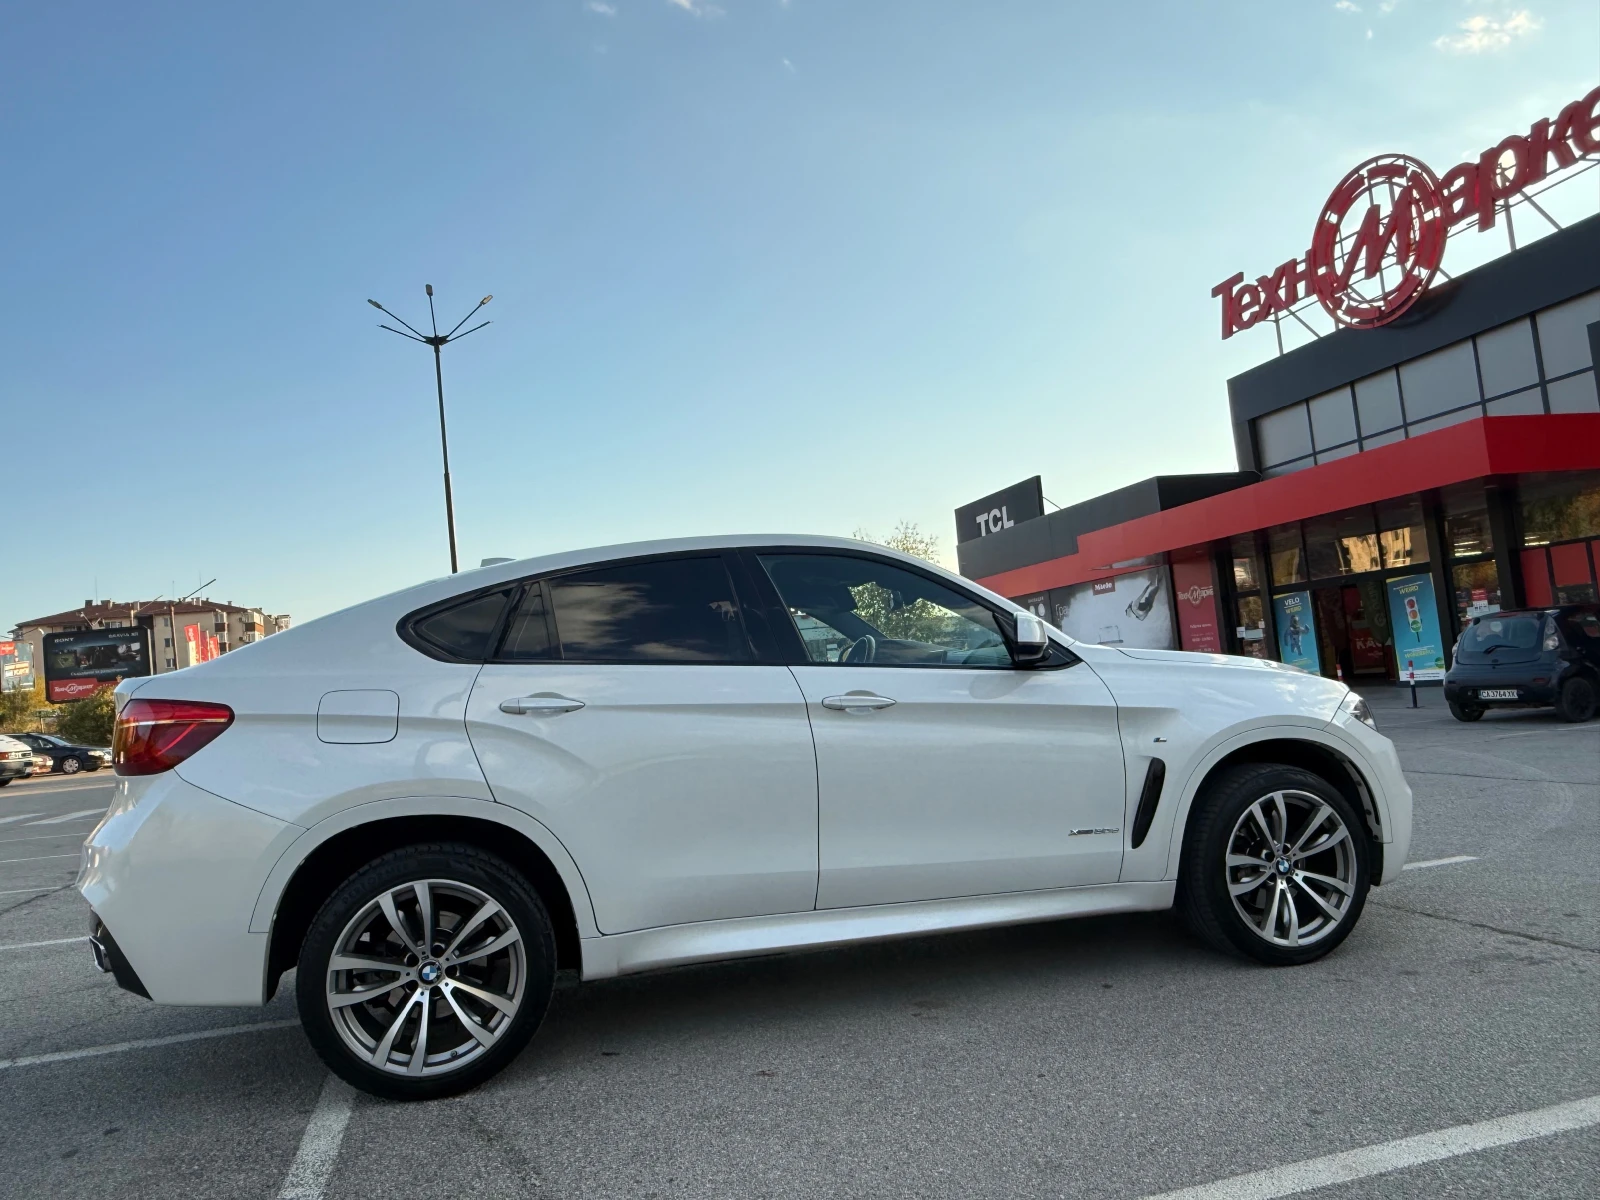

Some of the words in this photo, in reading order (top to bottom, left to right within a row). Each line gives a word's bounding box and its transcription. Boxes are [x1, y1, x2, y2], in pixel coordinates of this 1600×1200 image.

[976, 505, 1014, 537] TCL
[1094, 582, 1113, 591] Miele
[1284, 597, 1300, 606] VELO
